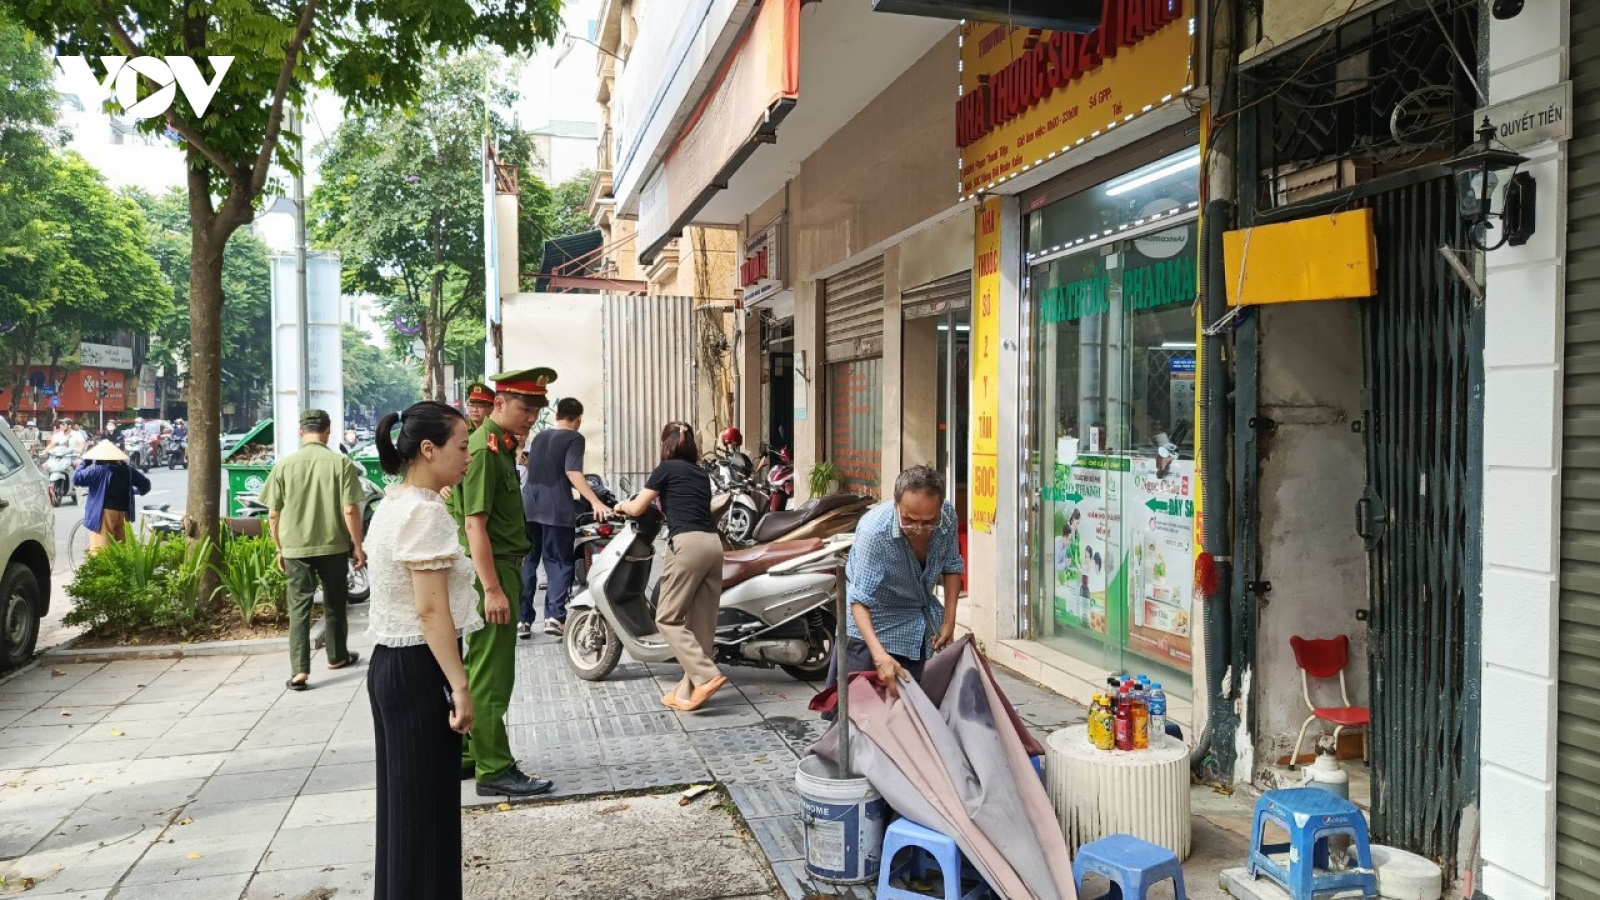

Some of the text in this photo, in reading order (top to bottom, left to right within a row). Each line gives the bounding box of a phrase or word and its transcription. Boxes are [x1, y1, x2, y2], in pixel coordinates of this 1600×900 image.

[1500, 102, 1562, 138] QUYẾT TIẾN
[974, 465, 995, 498] 50C
